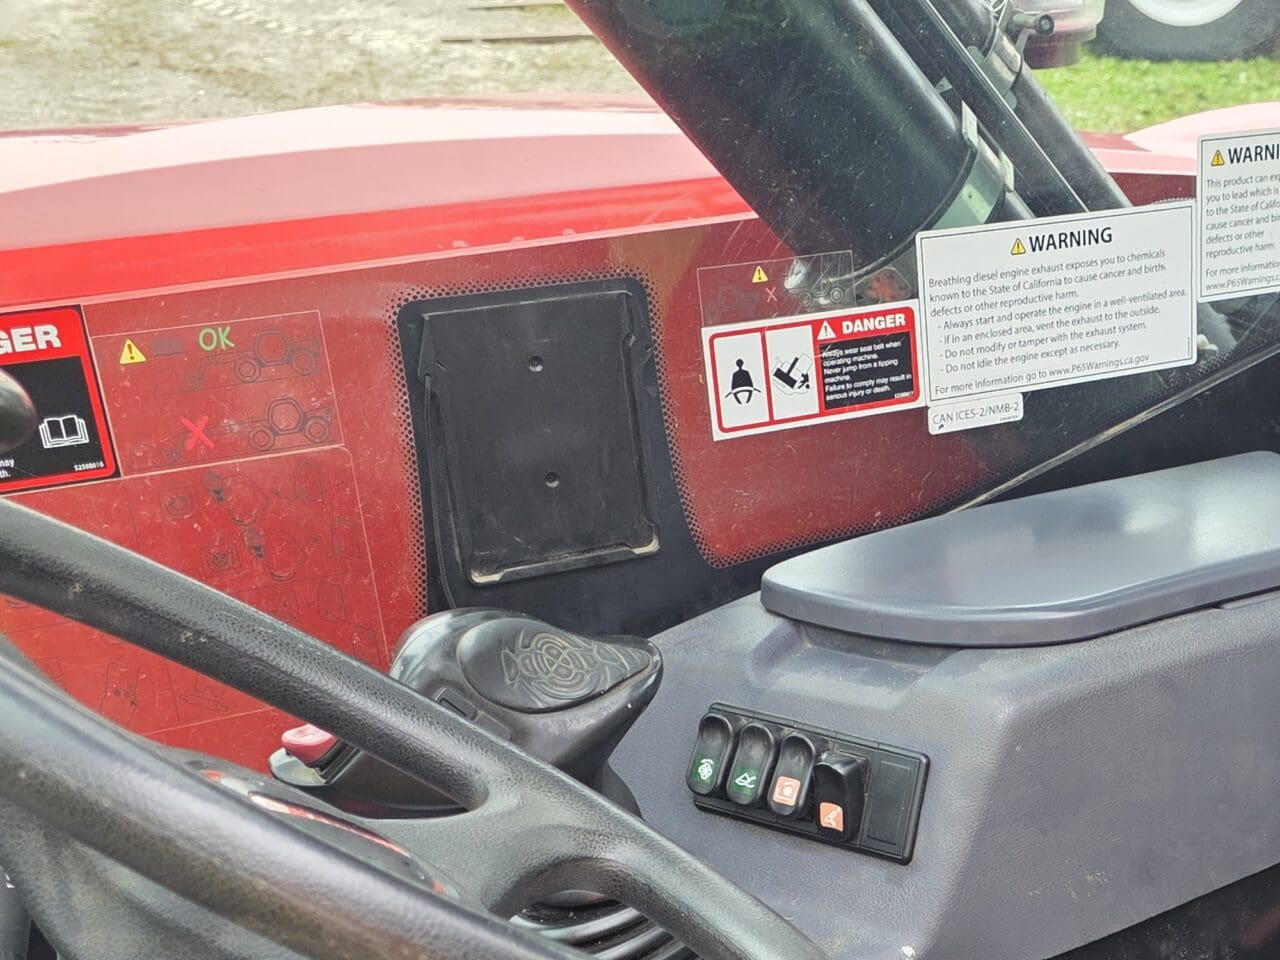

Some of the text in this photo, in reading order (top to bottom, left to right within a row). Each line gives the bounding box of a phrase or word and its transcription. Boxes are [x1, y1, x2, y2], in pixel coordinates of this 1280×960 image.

[1207, 178, 1222, 188] This
[1223, 174, 1253, 188] product
[1254, 174, 1268, 184] can
[1206, 194, 1220, 205] you
[1222, 192, 1230, 201] to
[1232, 189, 1248, 200] lead
[1250, 186, 1272, 198] which
[1274, 185, 1279, 194] is
[1206, 208, 1214, 217] to
[1216, 205, 1228, 216] the
[1230, 203, 1249, 214] State
[1250, 200, 1259, 211] of
[1206, 221, 1228, 231] cause
[1229, 216, 1254, 228] cancer
[1255, 214, 1269, 225] and
[1029, 227, 1113, 252] WARNING
[1206, 229, 1264, 244] defects or other
[1206, 241, 1276, 259] reproductive harm.
[929, 249, 1166, 288] Breathing diesel engine exhaust exposes you to chemicals
[1206, 268, 1218, 278] For
[1220, 265, 1239, 276] more
[930, 291, 959, 302] known
[962, 290, 970, 298] to
[973, 287, 987, 297] the
[989, 284, 1010, 295] State
[1012, 282, 1021, 291] of
[1023, 278, 1062, 290] California
[1064, 276, 1072, 285] to
[1074, 273, 1097, 283] cause
[1099, 269, 1125, 280] cancer
[1127, 266, 1142, 276] and
[930, 290, 1079, 317] defects or other reproductive harm.
[943, 318, 973, 330] Always
[975, 315, 996, 325] start
[997, 312, 1012, 322] and
[1014, 309, 1047, 322] operate
[1049, 306, 1062, 315] the
[1064, 302, 1092, 313] engine
[1094, 300, 1101, 309] in
[1109, 289, 1167, 306] well-ventilated
[1169, 289, 1187, 298] area.
[842, 313, 906, 335] DANGER
[944, 335, 950, 344] If
[952, 334, 960, 344] in
[962, 333, 973, 342] an
[975, 328, 1012, 341] enclosed
[1014, 326, 1034, 335] area,
[1036, 321, 1054, 331] vent
[1056, 317, 1070, 327] the
[1071, 314, 1103, 326] exhaust
[1105, 312, 1113, 321] to
[1115, 310, 1128, 319] the
[1130, 306, 1160, 317] outside.
[199, 326, 235, 351] OK
[945, 349, 957, 359] Do
[959, 347, 974, 357] not
[976, 342, 1006, 354] modify
[1018, 336, 1049, 348] tamper
[1051, 331, 1068, 342] with
[1071, 330, 1083, 340] the
[1085, 326, 1117, 338] exhaust
[1118, 321, 1147, 334] system.
[946, 364, 958, 373] Do
[960, 361, 975, 371] not
[977, 358, 992, 369] idle
[994, 356, 1009, 366] the
[1010, 352, 1040, 365] engine
[1041, 347, 1067, 359] except
[1069, 345, 1078, 353] as
[1080, 340, 1120, 353] necessary.
[935, 355, 1150, 395] For more information go to www.P65Warnings.ca.gov
[933, 401, 1020, 424] CAN ICES-2/NMB-2
